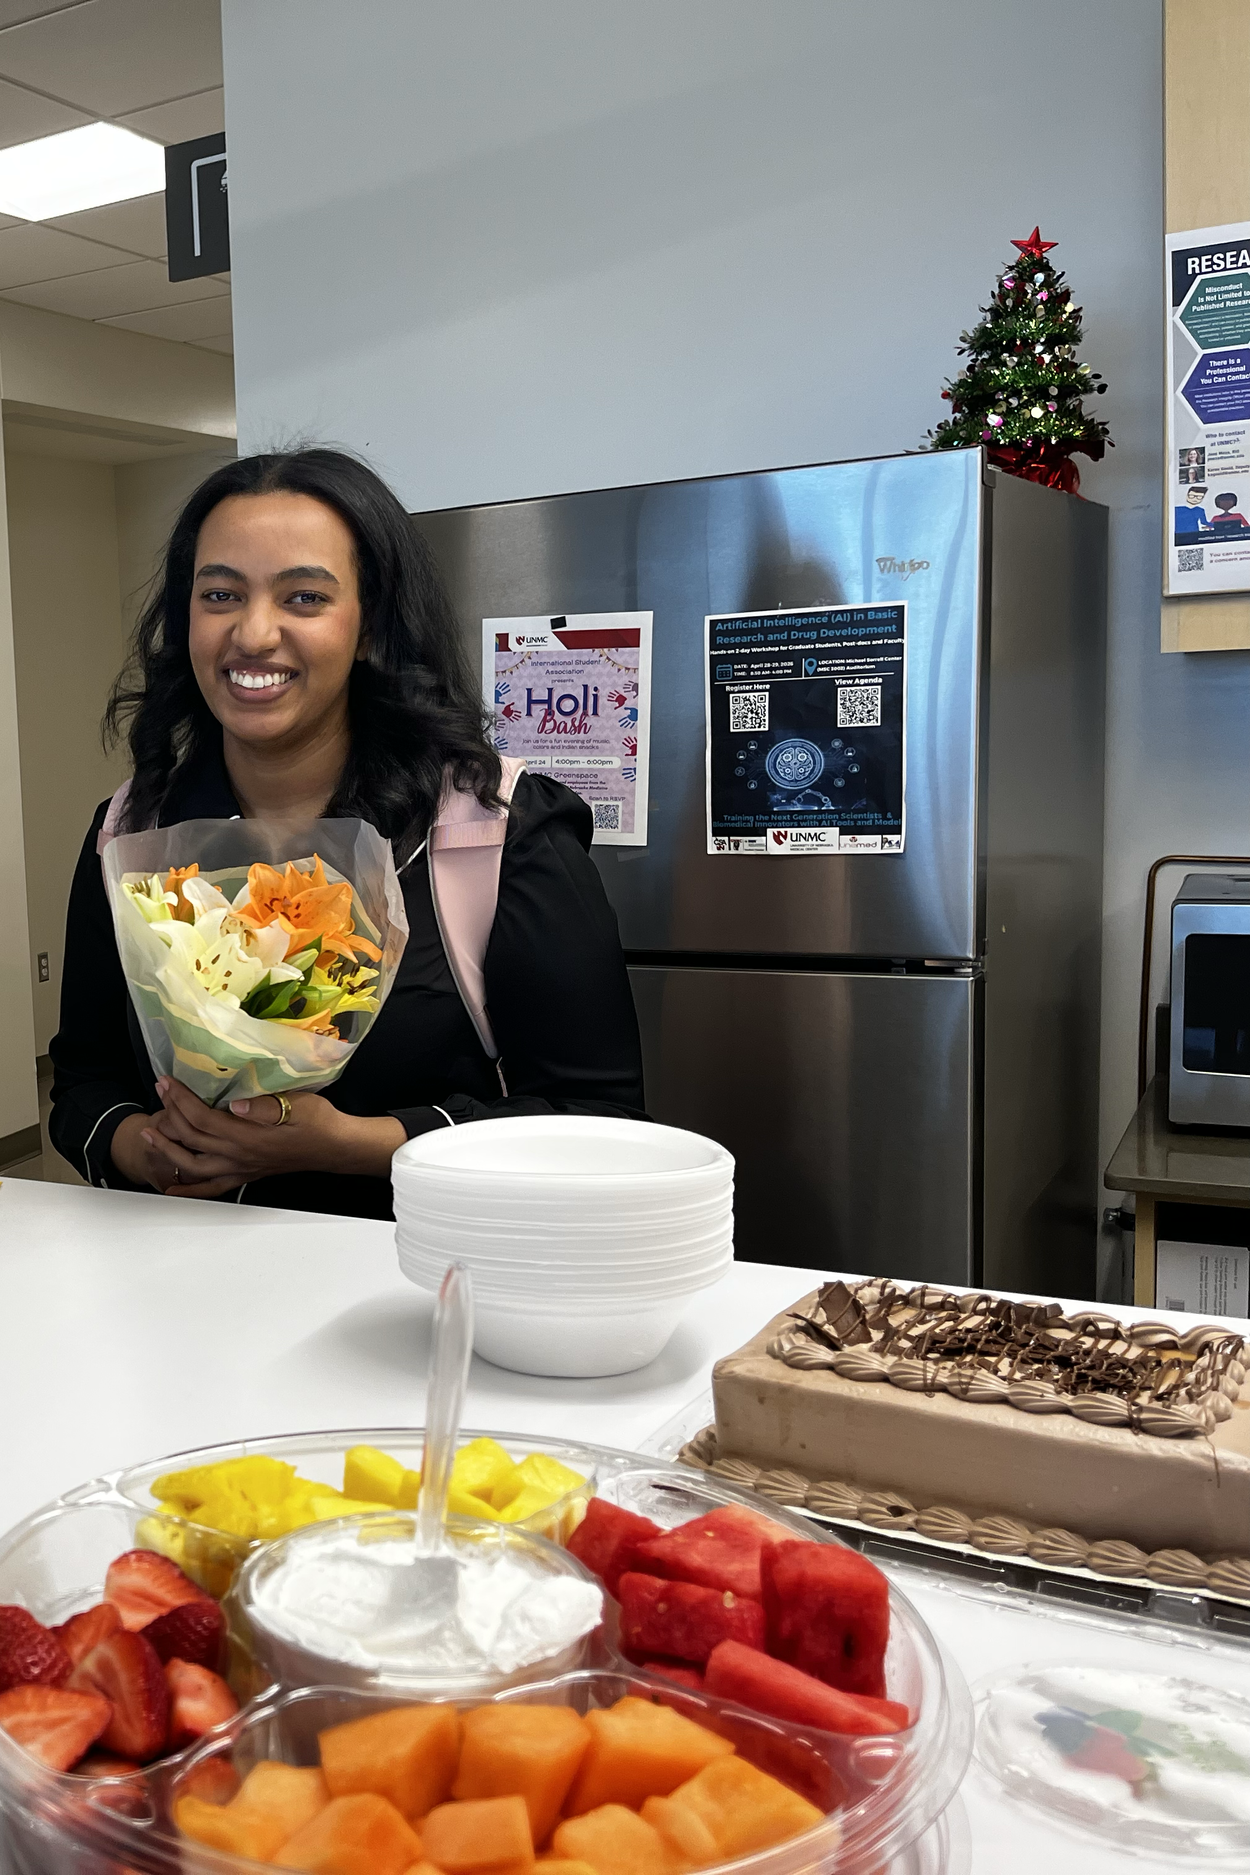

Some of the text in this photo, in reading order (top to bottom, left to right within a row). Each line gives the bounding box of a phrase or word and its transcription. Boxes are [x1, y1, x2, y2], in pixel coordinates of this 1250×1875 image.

[1205, 283, 1243, 293] Misconduct
[1218, 291, 1242, 300] Limited
[1192, 302, 1224, 312] Published
[1209, 359, 1227, 367] There
[1206, 365, 1246, 375] Professional
[715, 609, 898, 631] Artificial Intelligence (AI) in Basic
[716, 624, 897, 645] Research and Drug Development
[526, 636, 548, 644] UNMC
[854, 676, 883, 685] Agenda
[525, 684, 600, 717] Holi
[537, 708, 592, 735] Bash
[723, 814, 754, 823] Training
[792, 812, 839, 821] Generation
[841, 812, 883, 820] Scientists
[713, 820, 754, 828] Biomedical
[755, 820, 799, 828] Innovators
[800, 819, 819, 827] with
[821, 819, 831, 827] AI
[832, 818, 855, 827] Tools
[857, 818, 873, 827] and
[790, 832, 826, 843] UNMC
